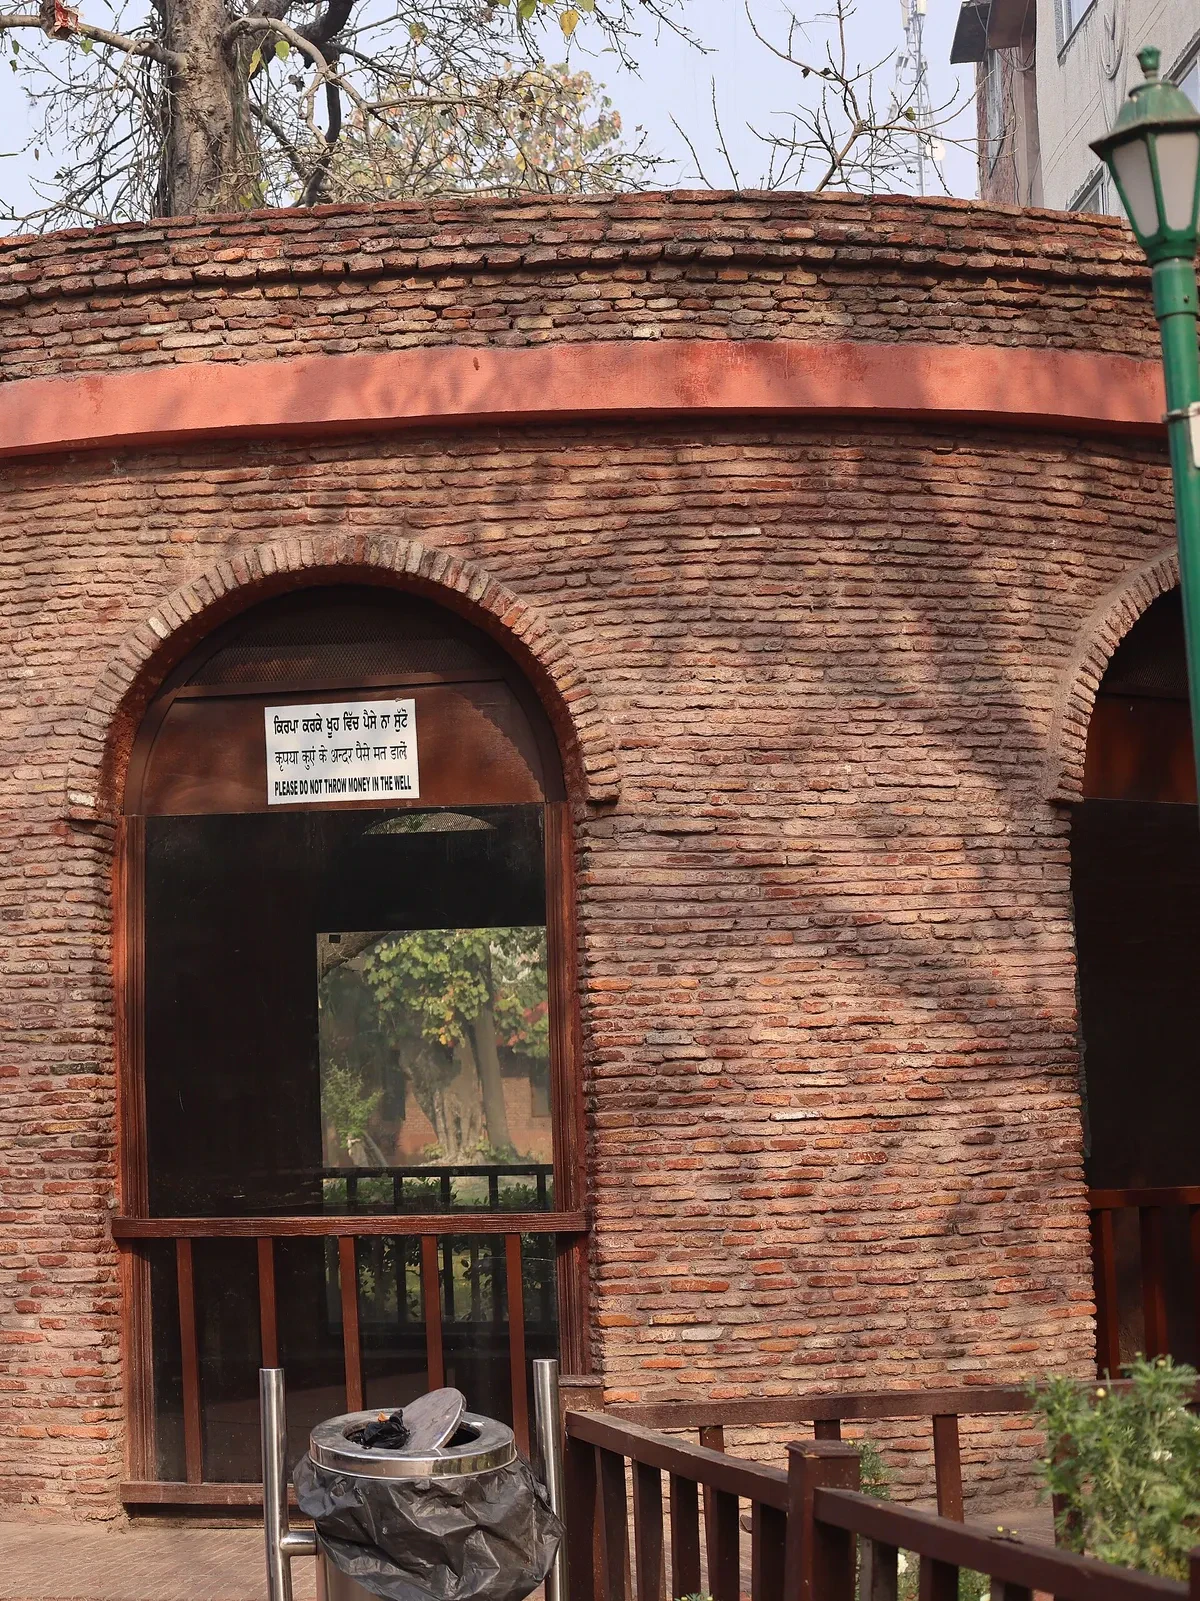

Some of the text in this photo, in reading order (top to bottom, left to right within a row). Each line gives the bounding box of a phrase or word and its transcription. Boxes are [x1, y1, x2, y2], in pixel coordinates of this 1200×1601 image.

[274, 715, 299, 734] ਕਿਰਪਾ
[302, 713, 323, 733] ਕਰਕੇ
[326, 717, 340, 738] ਖੂਹ
[343, 711, 360, 731] ਵਿੱਚ
[363, 709, 377, 730] ਪੈਸੇ
[380, 715, 390, 729] ਨਾ
[274, 741, 407, 771] कृपया कुएं के अन्दर पैसे मत डालें
[274, 775, 411, 796] PLEASE DO NOT THROW MONEY IN THE WELL
